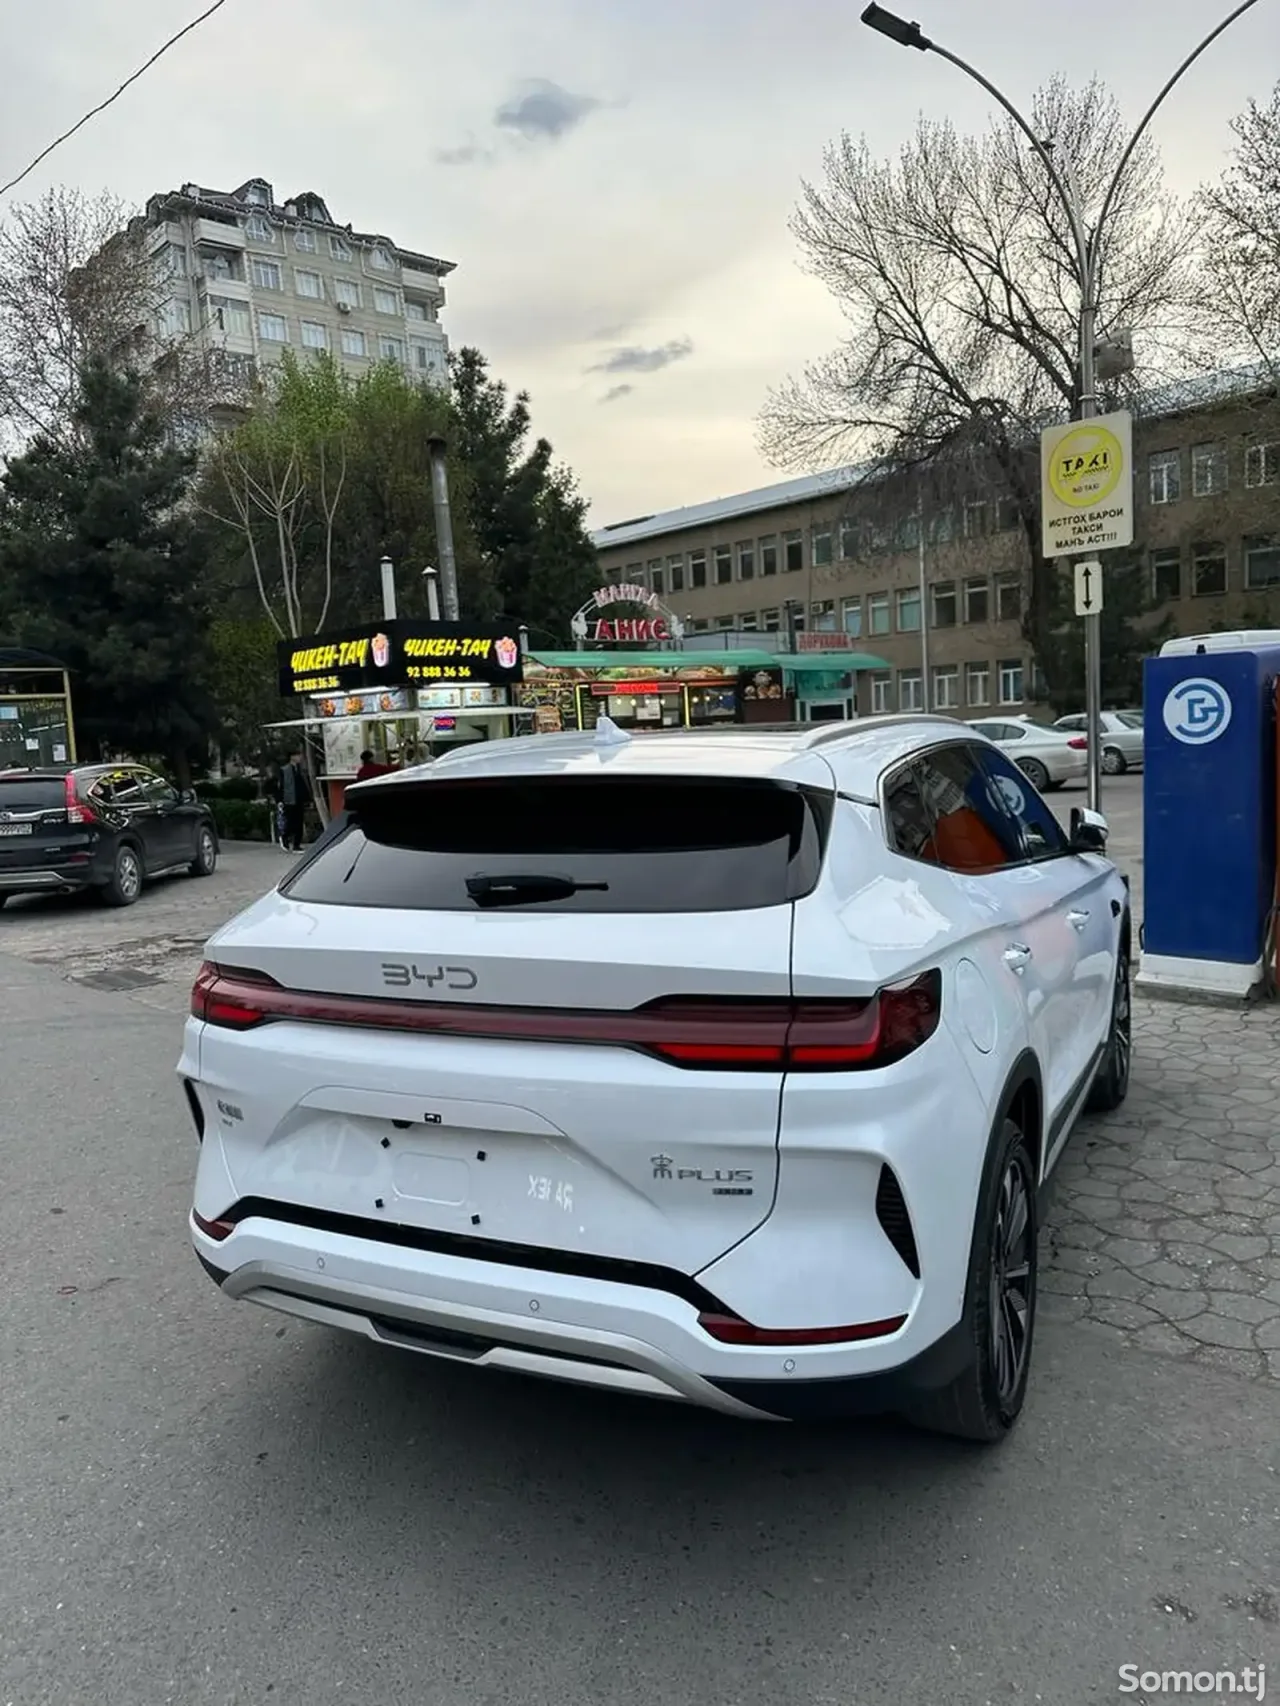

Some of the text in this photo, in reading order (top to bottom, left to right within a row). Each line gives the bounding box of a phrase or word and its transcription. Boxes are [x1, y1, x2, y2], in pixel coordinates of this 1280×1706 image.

[1062, 452, 1108, 473] TAXI
[1071, 523, 1103, 536] ТАКСИ
[1055, 537, 1084, 549] МАНЪ
[594, 616, 671, 641] АНИС
[406, 666, 471, 678] 92 888 36 36
[382, 963, 478, 990] BYD
[677, 1169, 753, 1182] PLUS
